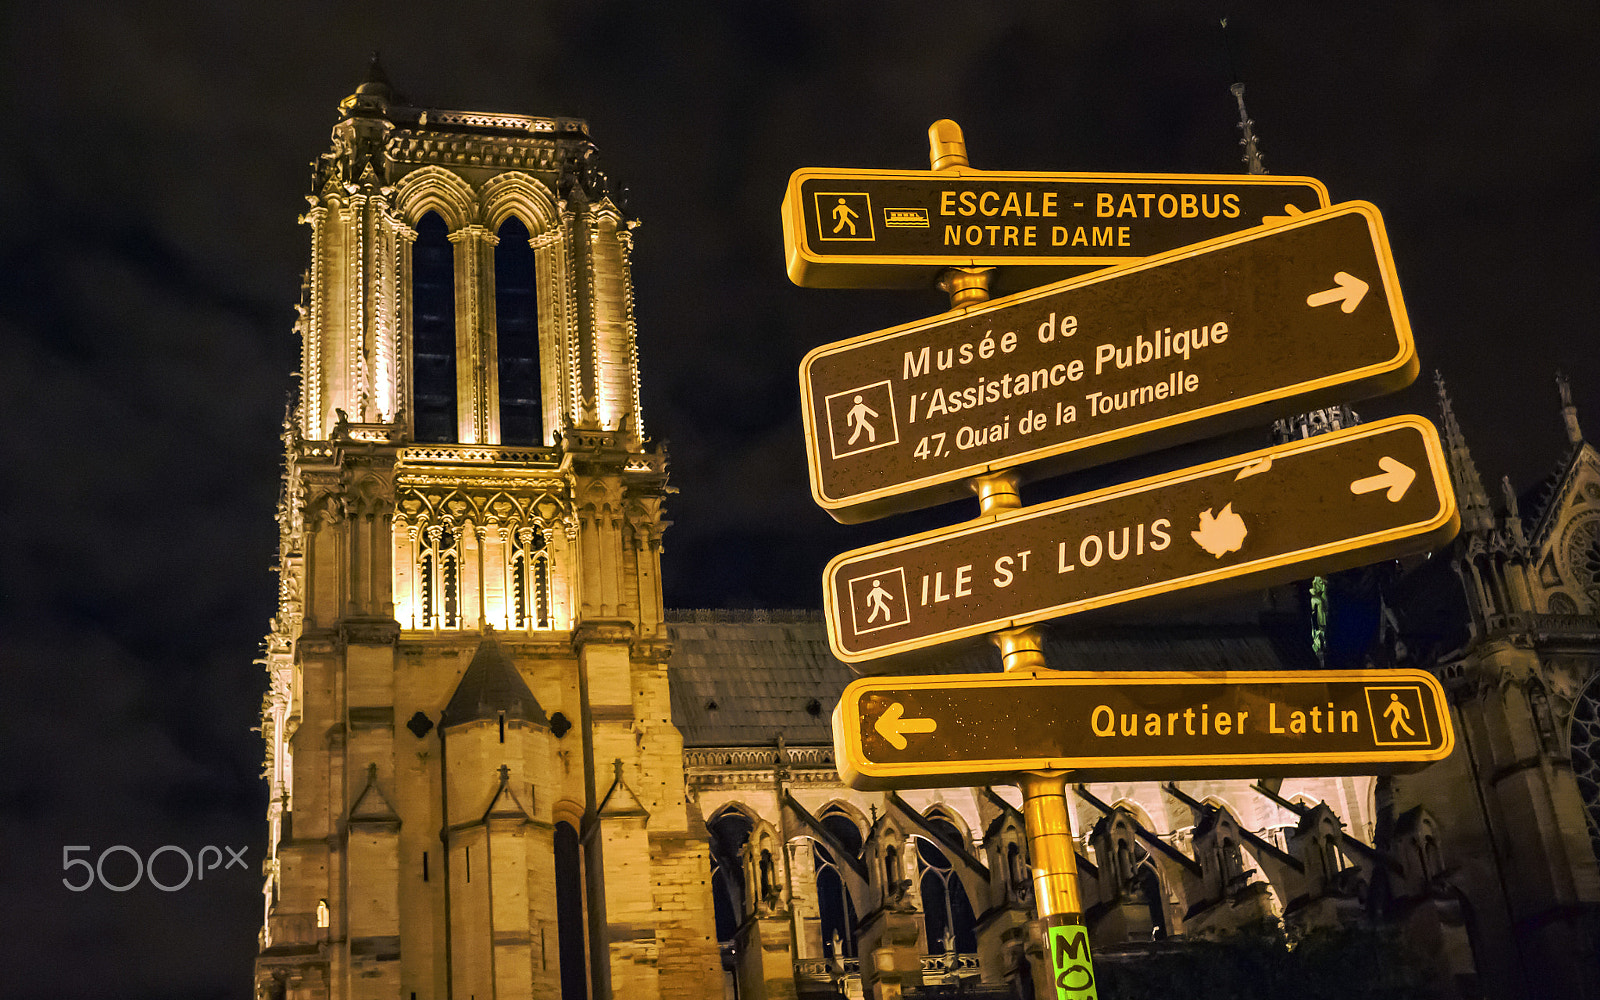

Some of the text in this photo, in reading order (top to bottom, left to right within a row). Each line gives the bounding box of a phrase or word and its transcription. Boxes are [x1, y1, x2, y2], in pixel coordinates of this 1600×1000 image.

[940, 190, 1058, 218] ESCALE
[1096, 192, 1241, 219] BATOBUS
[943, 224, 1131, 247] NOTRE DAME
[902, 312, 1078, 380] Musée de
[1095, 321, 1229, 375] Publique
[913, 370, 1200, 460] 47, Quai de la Tournelle
[920, 563, 973, 607] ILE
[1057, 518, 1172, 574] LOUIS
[1090, 702, 1359, 738] Quartier Latin
